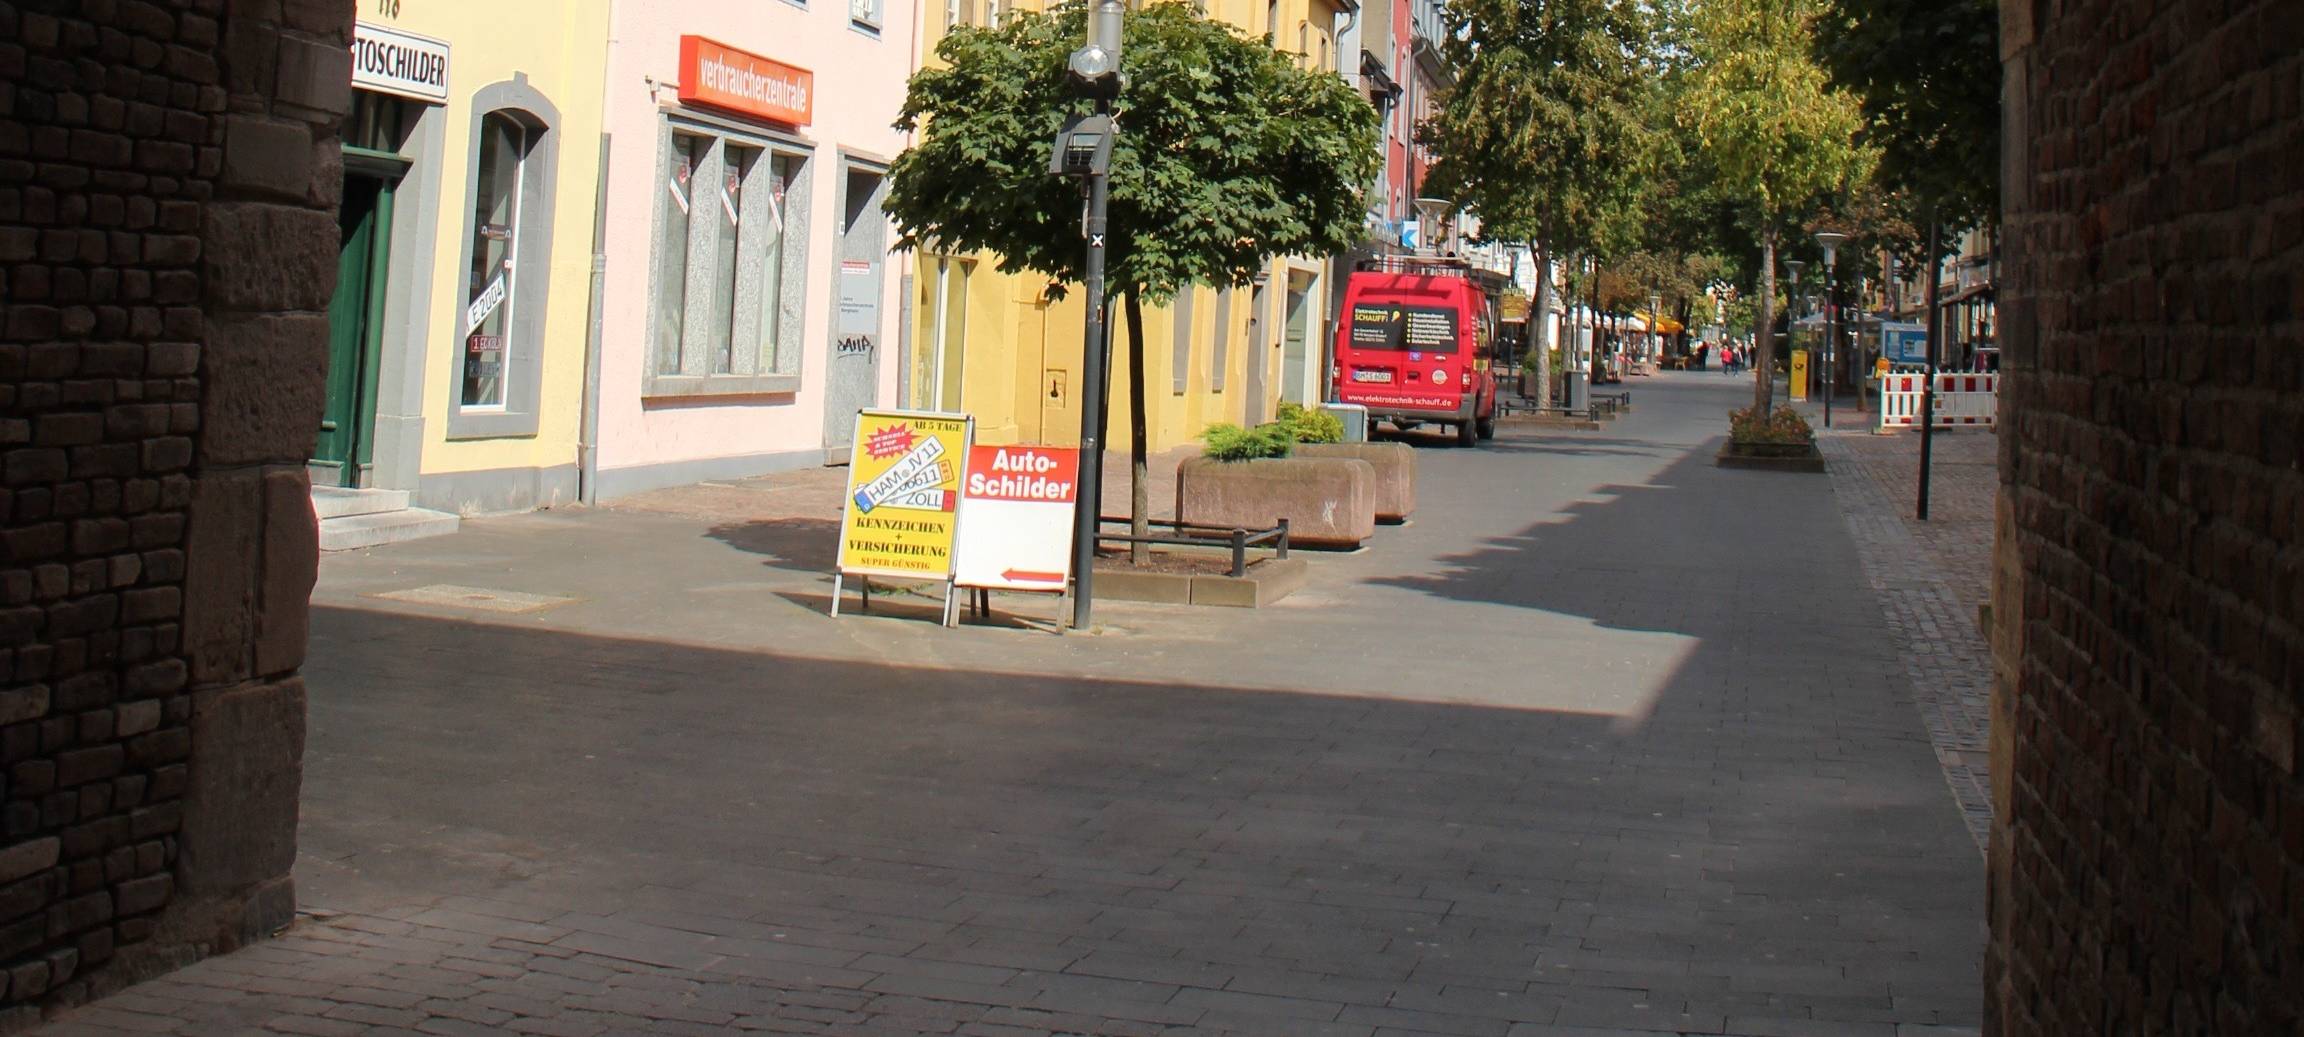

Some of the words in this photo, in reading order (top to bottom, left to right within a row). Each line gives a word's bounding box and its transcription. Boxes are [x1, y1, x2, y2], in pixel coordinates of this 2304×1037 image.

[354, 37, 445, 87] TOSCHILDER
[700, 54, 807, 112] verbraucherzentrale
[1347, 393, 1452, 407] www.elektrotechnik-schauff.de
[914, 421, 926, 430] AB
[928, 421, 935, 430] 5
[937, 422, 962, 432] TAGE
[992, 449, 1057, 473] Auto-
[868, 471, 903, 501] HAM
[921, 442, 940, 459] 11
[969, 473, 1071, 499] Schilder
[905, 490, 941, 507] ZOLL
[856, 517, 945, 534] KENNZEICHEN
[849, 539, 947, 558] VERSICHERUNG
[861, 557, 890, 567] SUPER
[892, 558, 931, 570] GÜNSTIG
